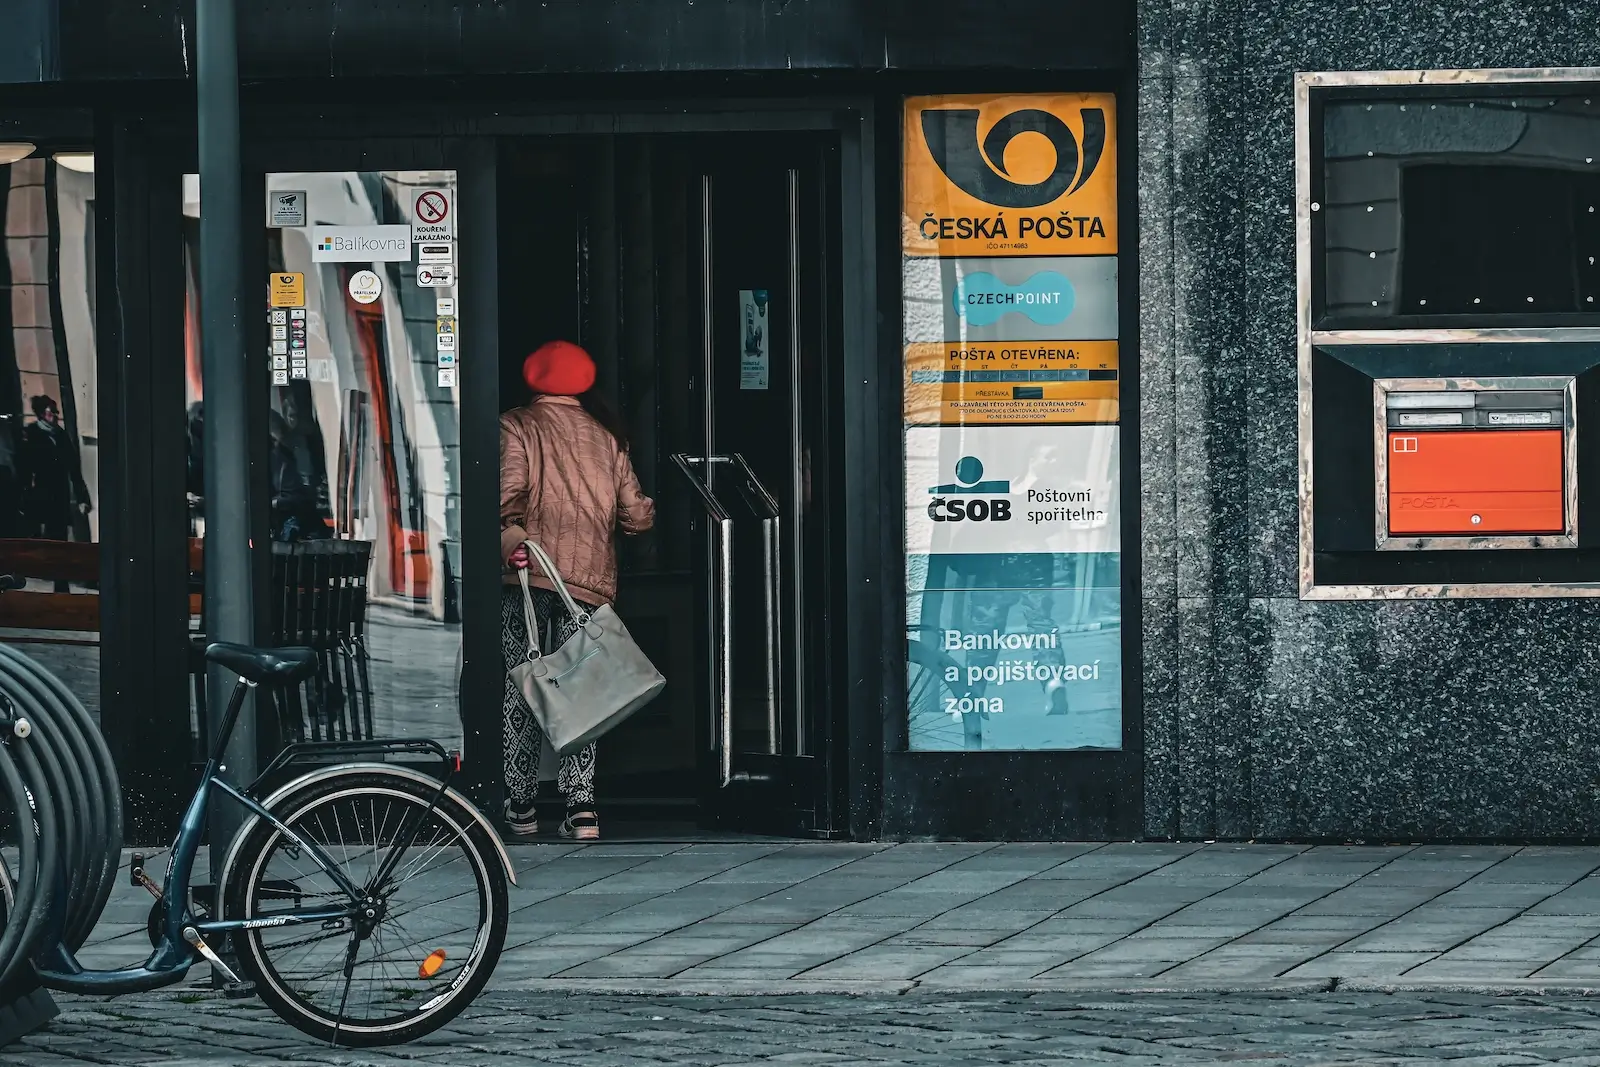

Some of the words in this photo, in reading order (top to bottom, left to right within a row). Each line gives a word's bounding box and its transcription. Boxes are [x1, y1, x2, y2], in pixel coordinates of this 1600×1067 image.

[416, 225, 447, 233] KOUŘENÍ
[919, 212, 1008, 240] ČESKÁ
[1019, 211, 1106, 239] POŠTA
[334, 236, 406, 251] Balíkovna
[413, 233, 451, 241] ZAKÁZÁNO
[967, 292, 1061, 305] CZECHPOINT
[950, 348, 996, 361] POŠTA
[1000, 346, 1080, 360] OTEVŘENA:
[975, 389, 1009, 397] PŘESTÁVKA
[1027, 488, 1091, 503] Poštovní
[927, 496, 1012, 522] ČSOB
[1027, 507, 1104, 524] spořitelna
[944, 627, 1059, 650] Bankovní
[944, 665, 959, 682] a
[967, 659, 1101, 686] pojišťovací
[944, 692, 1004, 714] zóna
